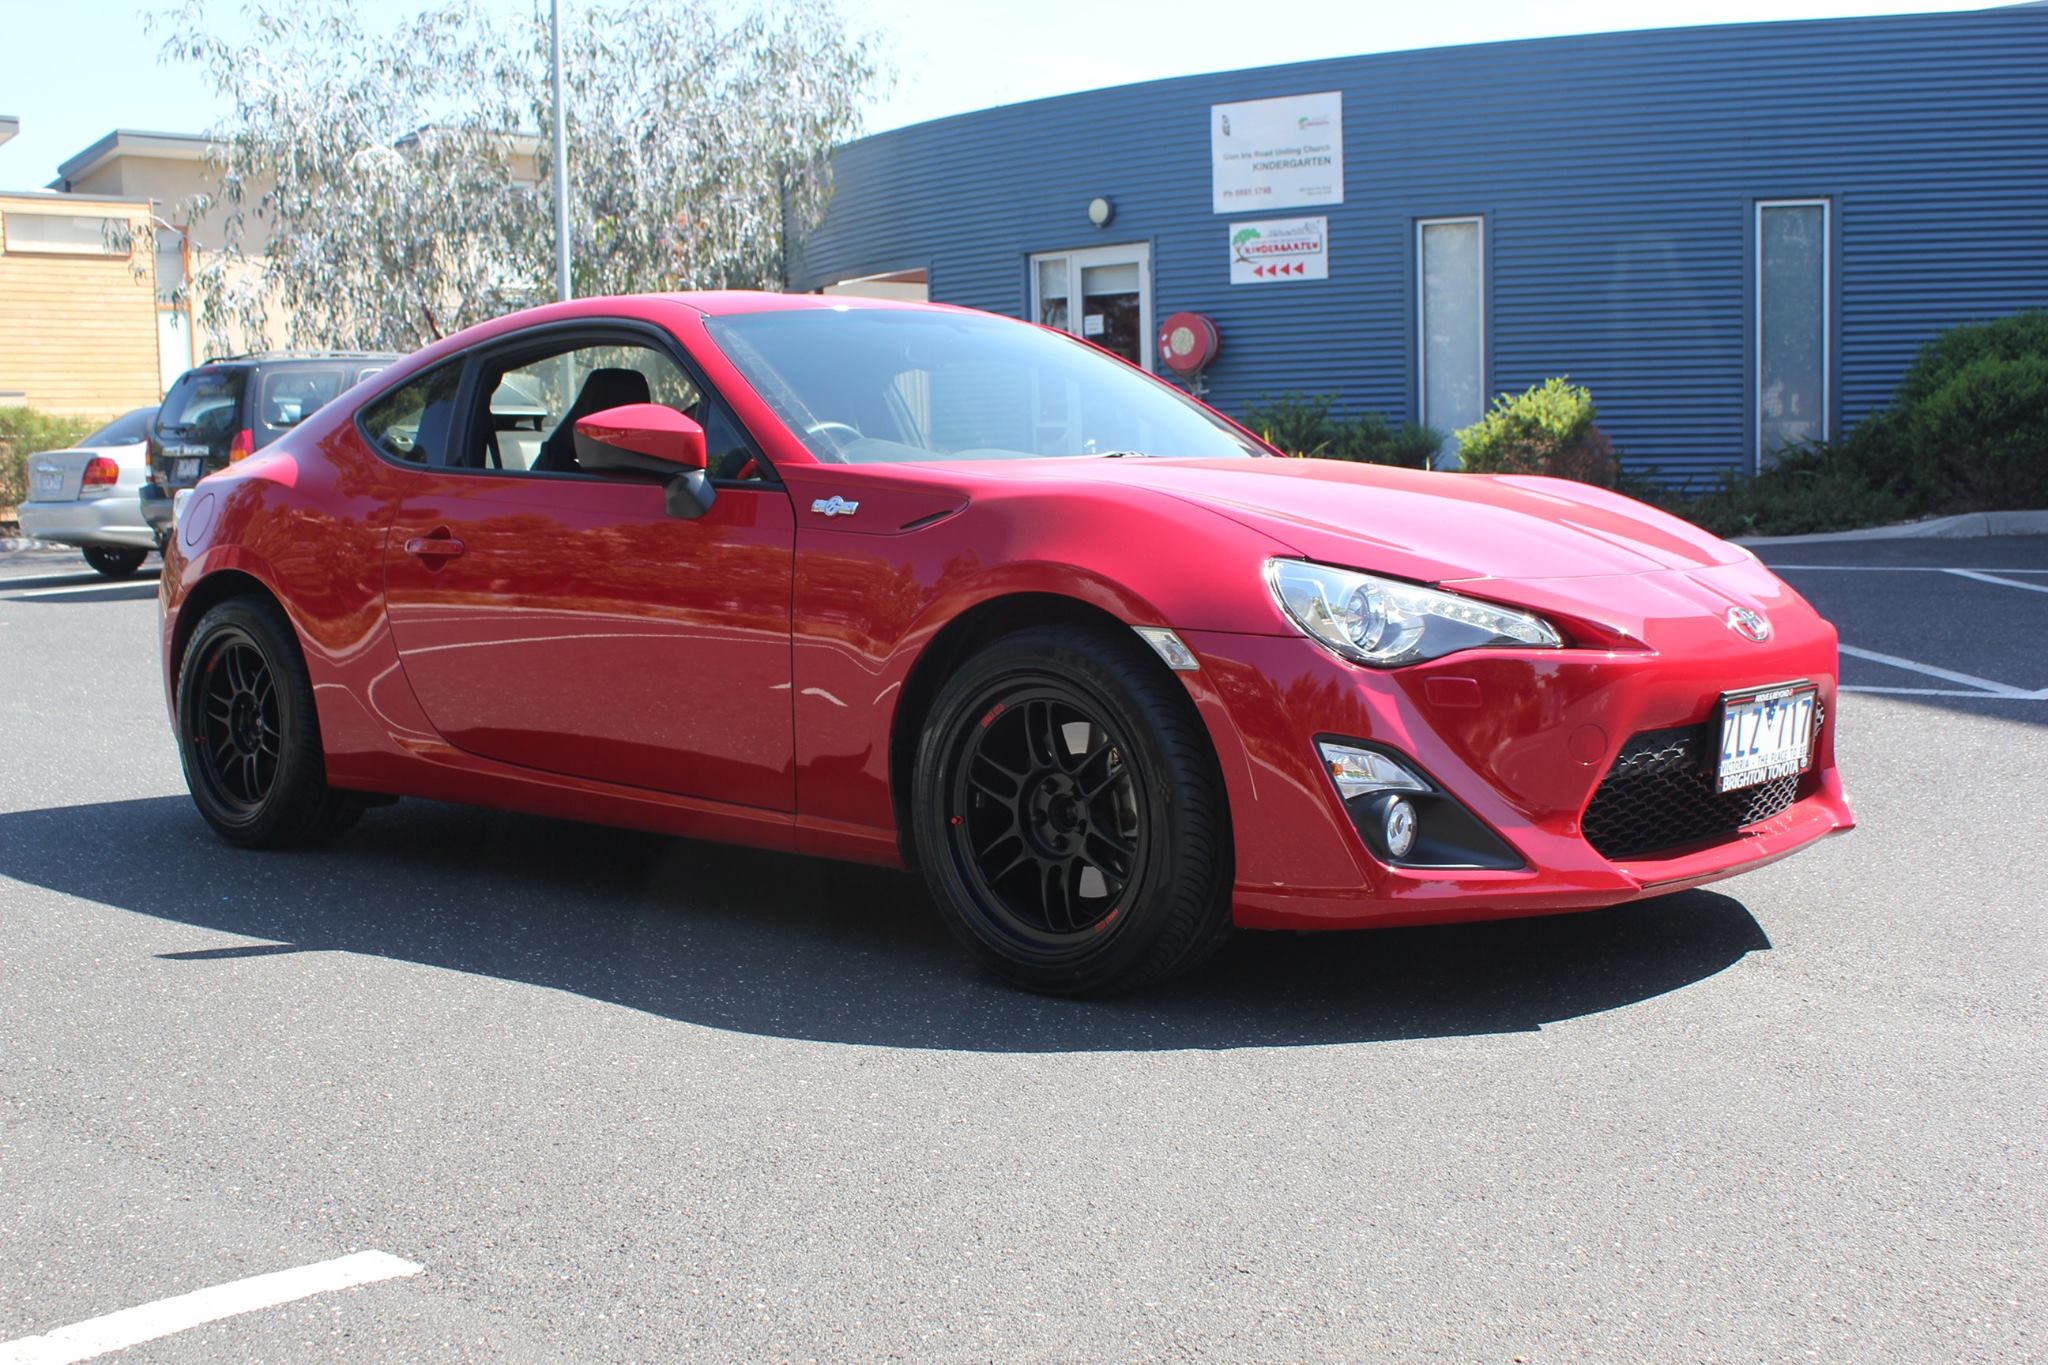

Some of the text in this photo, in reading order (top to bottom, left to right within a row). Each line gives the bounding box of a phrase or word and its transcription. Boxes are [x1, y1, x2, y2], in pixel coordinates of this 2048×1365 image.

[1254, 149, 1273, 157] Road
[1303, 144, 1331, 153] Church
[1253, 156, 1331, 172] KINDERGARTEN
[1244, 241, 1319, 255] KINDERGARTEN
[1722, 706, 1762, 760] ZLZ
[1721, 759, 1749, 774] VICTORIA
[1757, 754, 1768, 765] THE
[1771, 749, 1788, 762] PLACE
[1789, 747, 1797, 758] TO
[1799, 745, 1807, 757] BE
[1722, 759, 1799, 792] BRIGHTON TOYOTA
